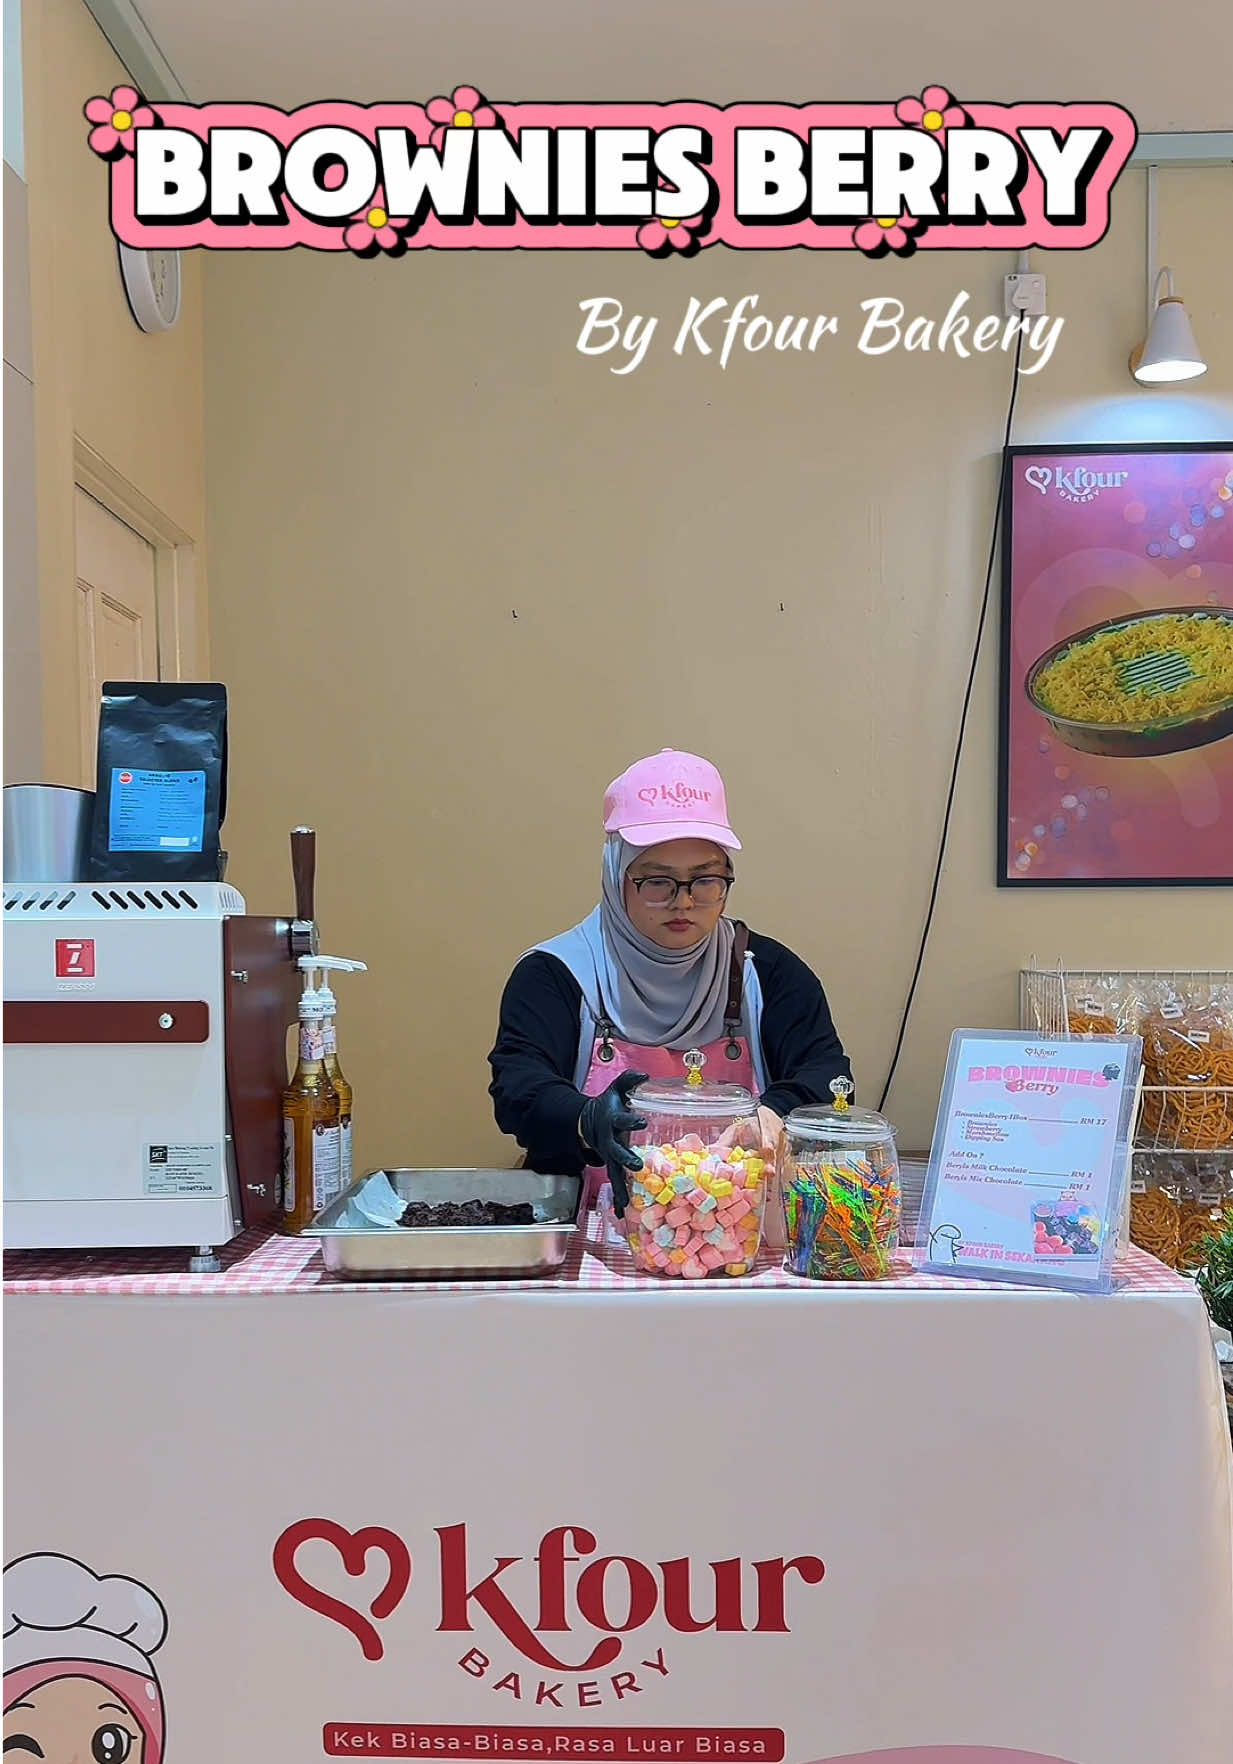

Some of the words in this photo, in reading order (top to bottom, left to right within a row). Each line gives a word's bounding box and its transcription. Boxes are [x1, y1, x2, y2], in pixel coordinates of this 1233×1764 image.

[1055, 466, 1128, 496] kfour
[1059, 488, 1100, 503] BAKERY
[661, 782, 711, 803] kfour
[967, 1065, 1112, 1089] BROWNIES
[1013, 1078, 1060, 1096] Berry
[948, 1150, 965, 1158] Add
[988, 1164, 1028, 1175] Chocolate
[984, 1175, 1024, 1186] Chocolate
[433, 1523, 826, 1673] kfour
[458, 1647, 671, 1707] BAKERY
[333, 1730, 382, 1749] Kek
[391, 1731, 616, 1755] Biasa-Biasa,Rasa
[627, 1735, 685, 1753] Luar
[695, 1736, 767, 1754] Biasa
